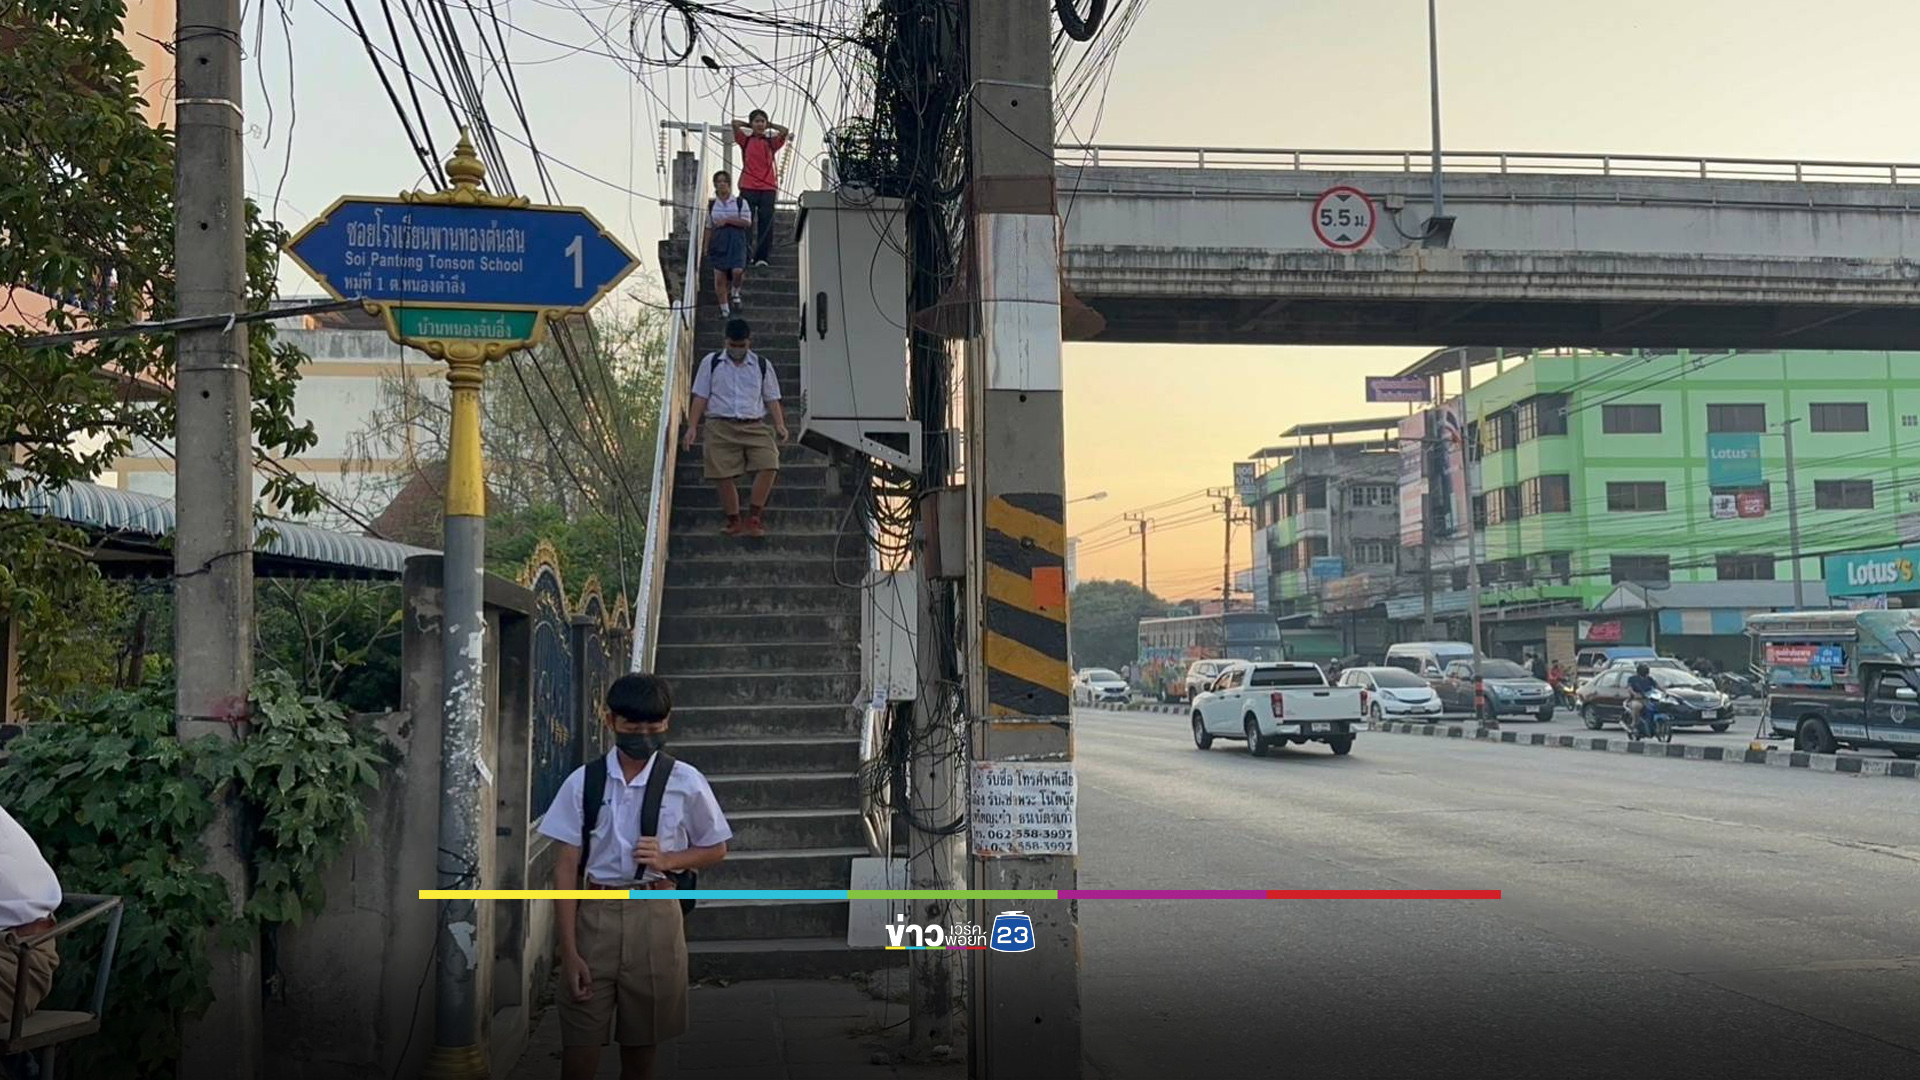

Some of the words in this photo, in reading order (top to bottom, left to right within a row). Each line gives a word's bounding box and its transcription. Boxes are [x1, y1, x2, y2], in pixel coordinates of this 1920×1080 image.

[1320, 208, 1351, 227] 5.5
[345, 252, 366, 266] Soi
[371, 252, 424, 272] Pantong
[428, 254, 475, 270] Tonson
[480, 256, 523, 272] School
[564, 234, 584, 289] 1
[344, 266, 372, 300] หมู่ที่
[377, 277, 384, 291] 1
[1848, 559, 1913, 586] Lotus's
[988, 829, 1073, 839] 062-558-3997
